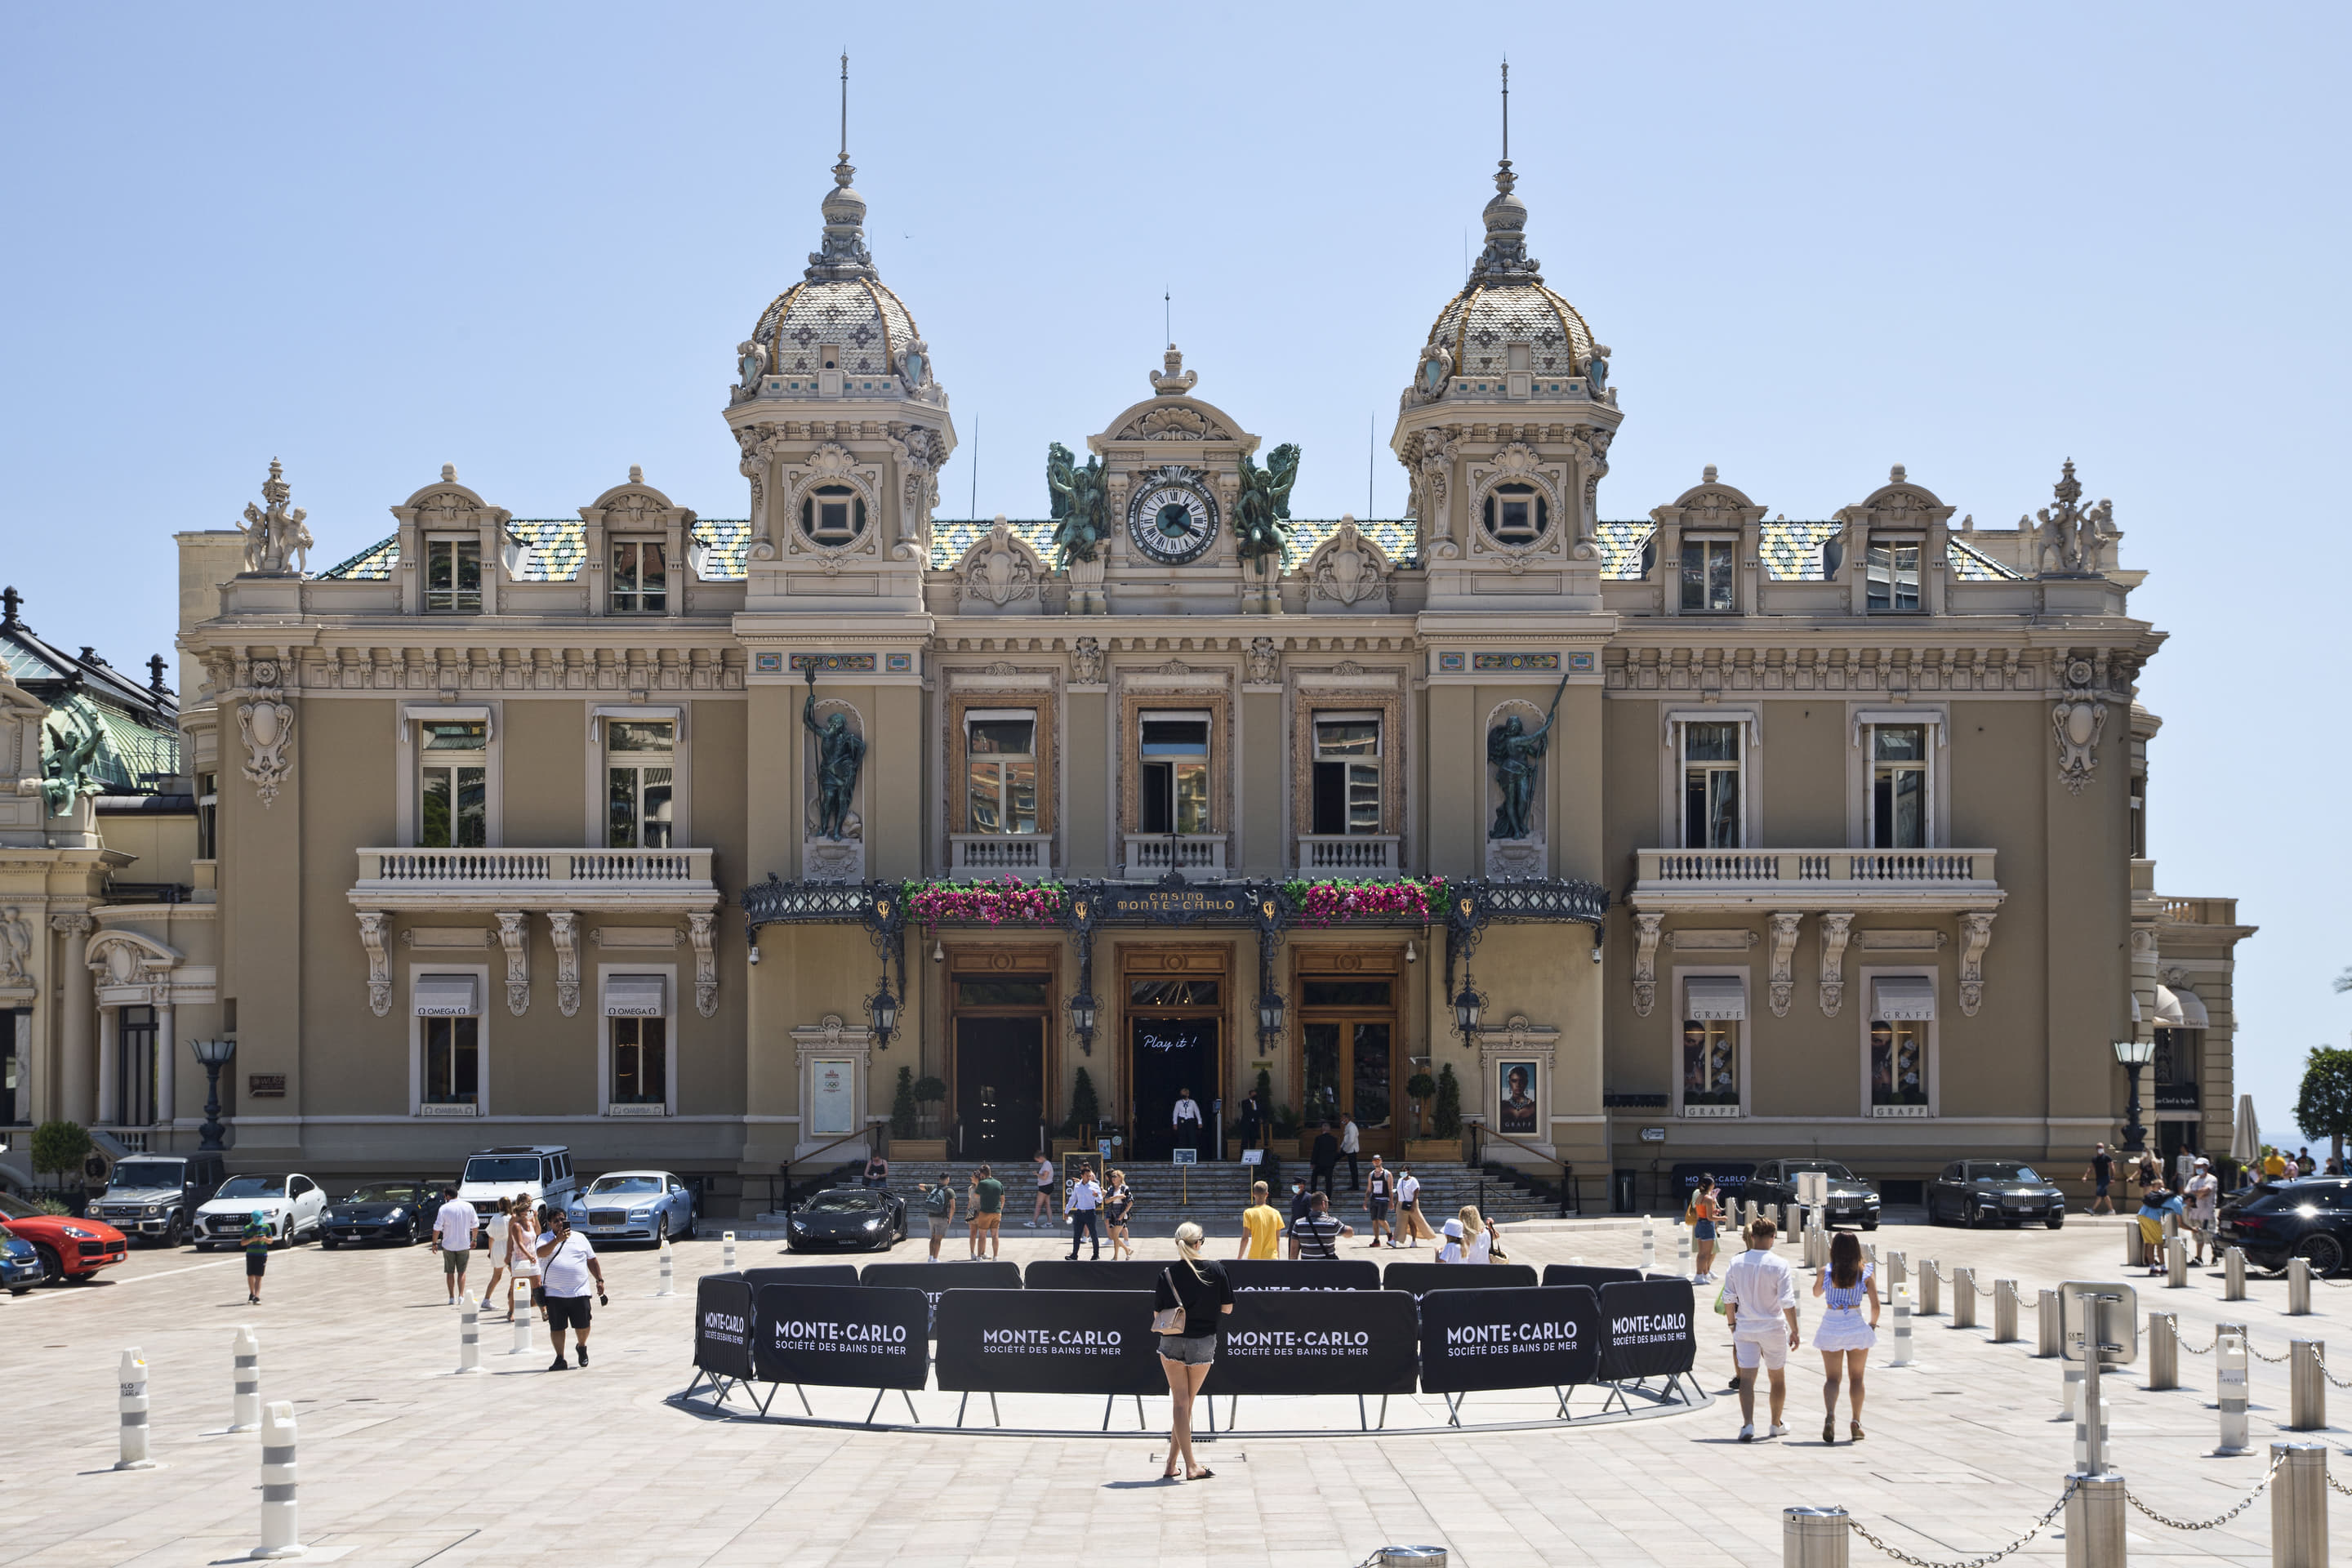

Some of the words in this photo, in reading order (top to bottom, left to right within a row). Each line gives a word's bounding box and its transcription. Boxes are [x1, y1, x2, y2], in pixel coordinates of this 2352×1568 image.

[1149, 893, 1204, 901] CASINO
[1694, 1011, 1742, 1019] GRAFF
[1883, 1011, 1932, 1019] GRAFF
[1143, 1035, 1174, 1052] Play
[1176, 1037, 1187, 1048] it
[1689, 1107, 1736, 1116] GRAFF
[1877, 1107, 1924, 1116] GRAFF
[1613, 1334, 1636, 1346] SOCIÉTÉ
[1637, 1335, 1648, 1343] DES
[1650, 1334, 1666, 1343] BAINS
[1668, 1333, 1674, 1341] DE
[1676, 1332, 1686, 1340] MER
[776, 1339, 815, 1350] SOCIÉTÉ
[819, 1343, 835, 1351] DES
[840, 1343, 867, 1352] BAINS
[871, 1345, 883, 1353] DE
[887, 1346, 906, 1355] MER
[1228, 1347, 1270, 1355] SOCIÉTÉ
[1449, 1344, 1486, 1356] SOCIÉTÉ
[1491, 1345, 1508, 1353] DES
[1513, 1343, 1539, 1352] BAINS
[1544, 1343, 1555, 1351] DE
[1558, 1342, 1577, 1350] MER
